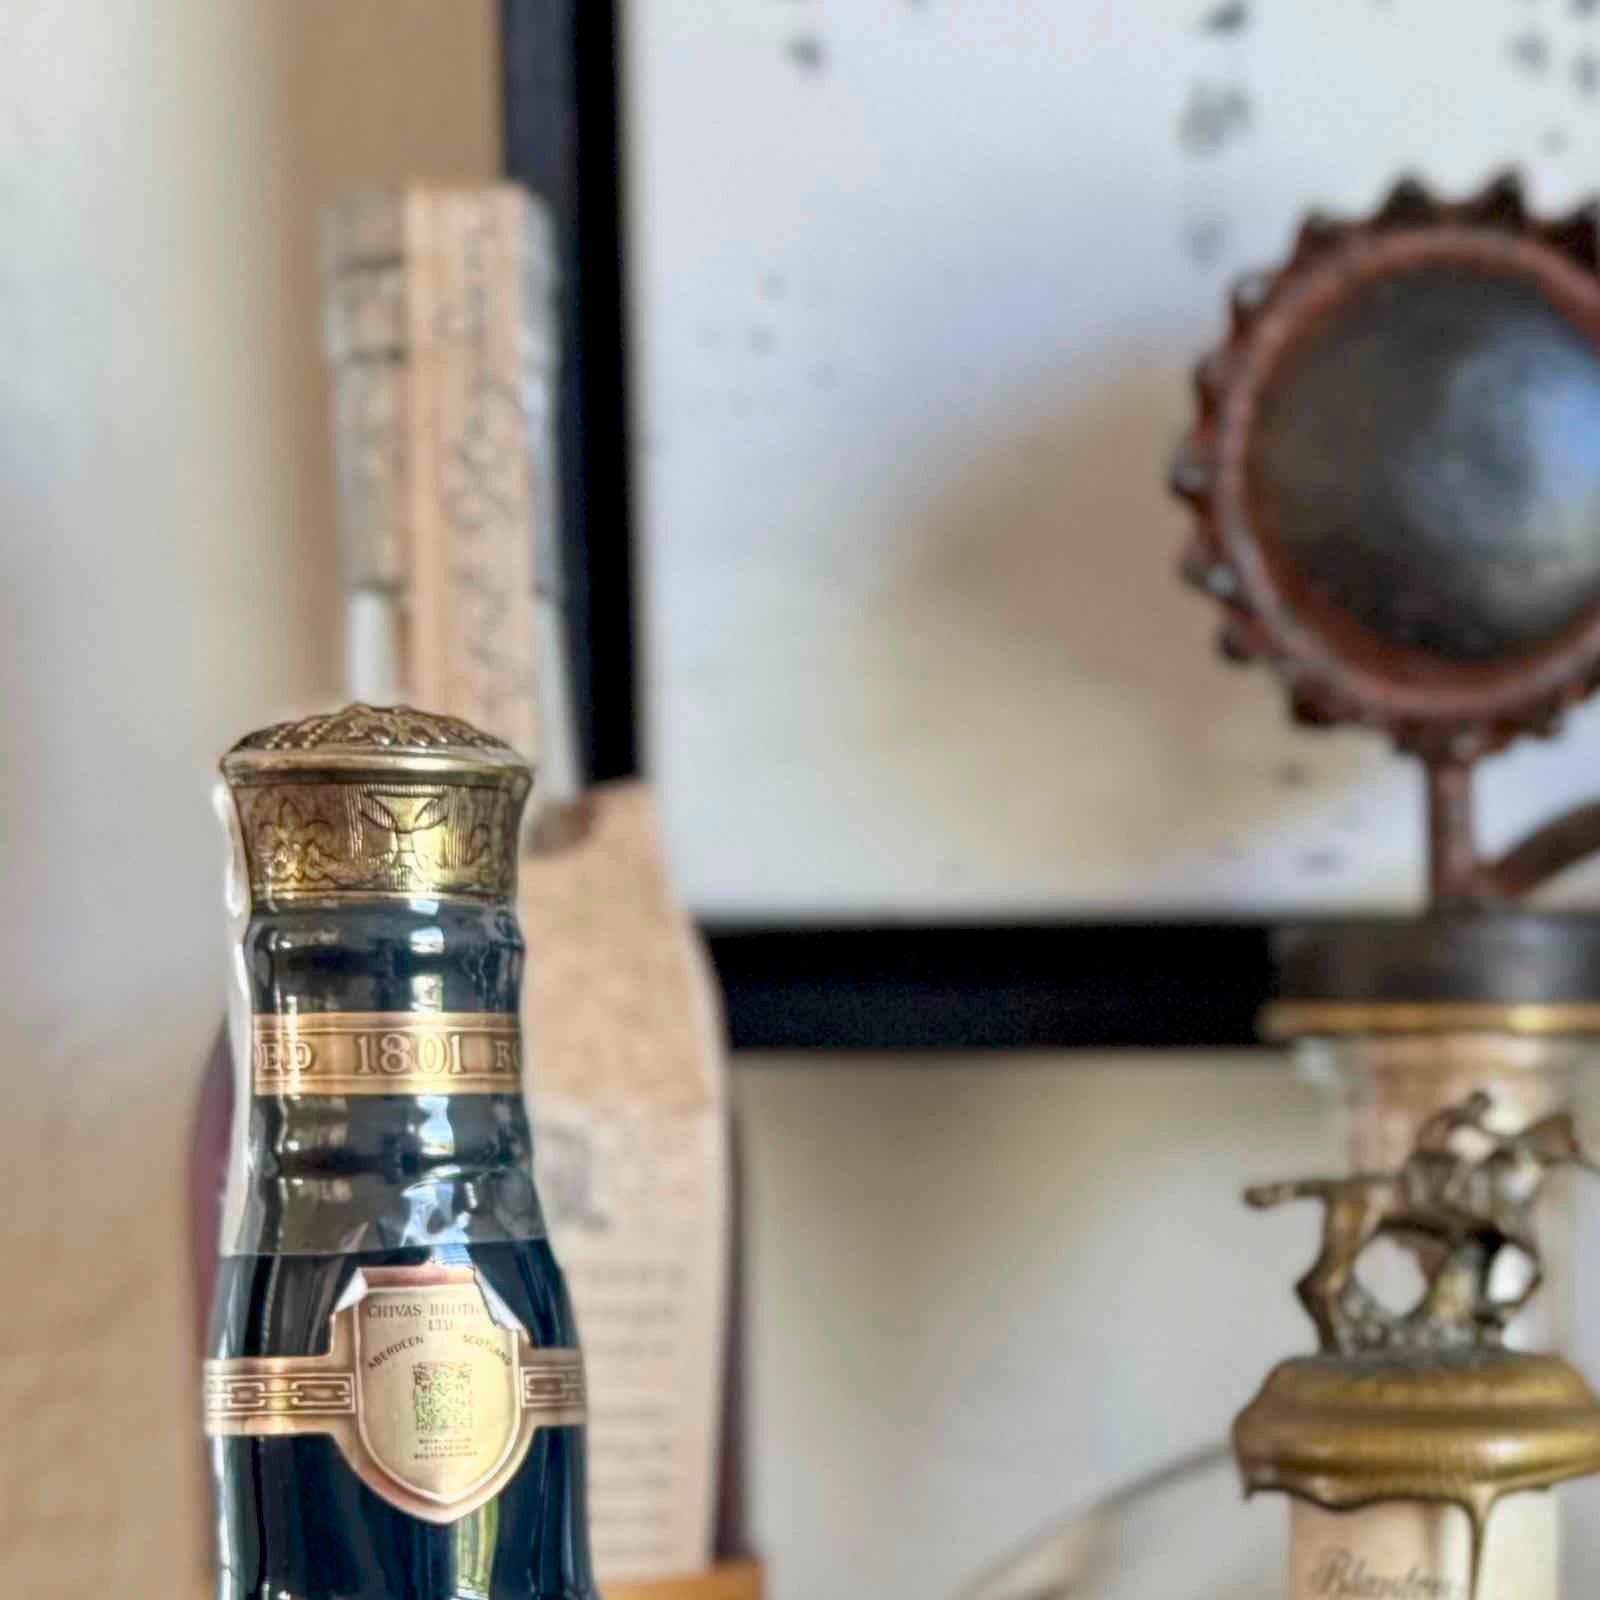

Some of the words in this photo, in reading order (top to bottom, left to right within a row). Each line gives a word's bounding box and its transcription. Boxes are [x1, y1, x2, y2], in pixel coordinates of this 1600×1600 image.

[357, 1032, 464, 1075] 1801
[367, 1302, 423, 1319] CHIVAS
[367, 1334, 425, 1371] ABERDEEN
